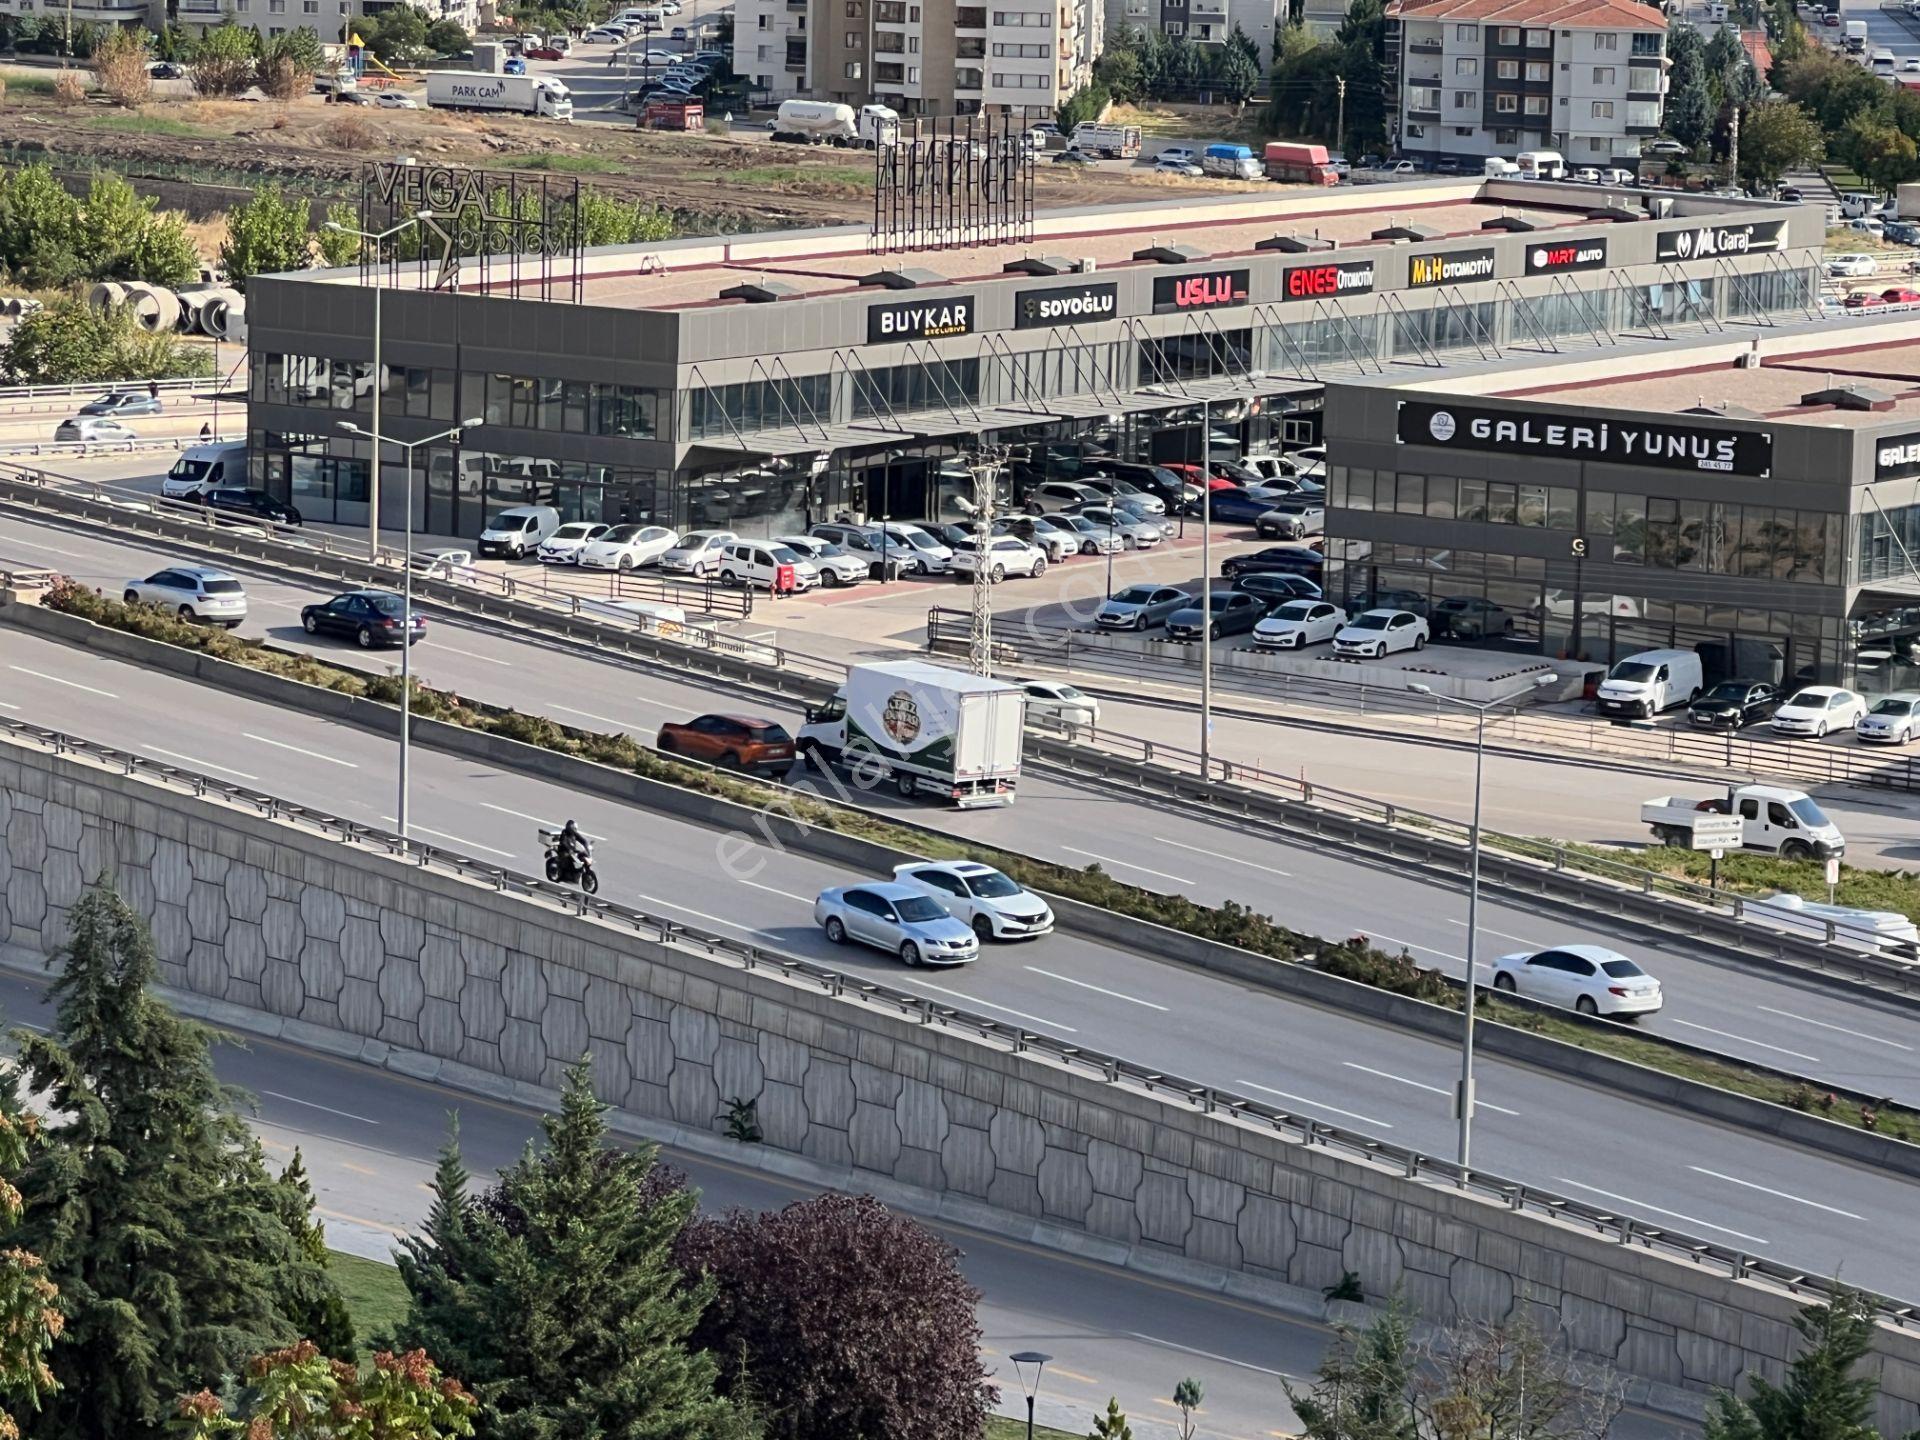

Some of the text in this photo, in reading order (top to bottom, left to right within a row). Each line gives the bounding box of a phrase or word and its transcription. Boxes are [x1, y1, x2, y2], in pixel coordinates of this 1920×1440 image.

[452, 85, 500, 98] PARK CAM
[373, 164, 490, 219] VEGA
[1718, 228, 1749, 253] Garaj
[1548, 248, 1603, 265] MRT AUTO
[1176, 275, 1232, 306] USLU
[1289, 266, 1338, 296] ENES
[1040, 291, 1113, 318] SOYOĞLU
[881, 305, 967, 334] BUYKAR
[924, 326, 966, 336] EXCLUSIVE
[1471, 418, 1736, 461] GALERİ YUNUS
[1572, 538, 1585, 552] G
